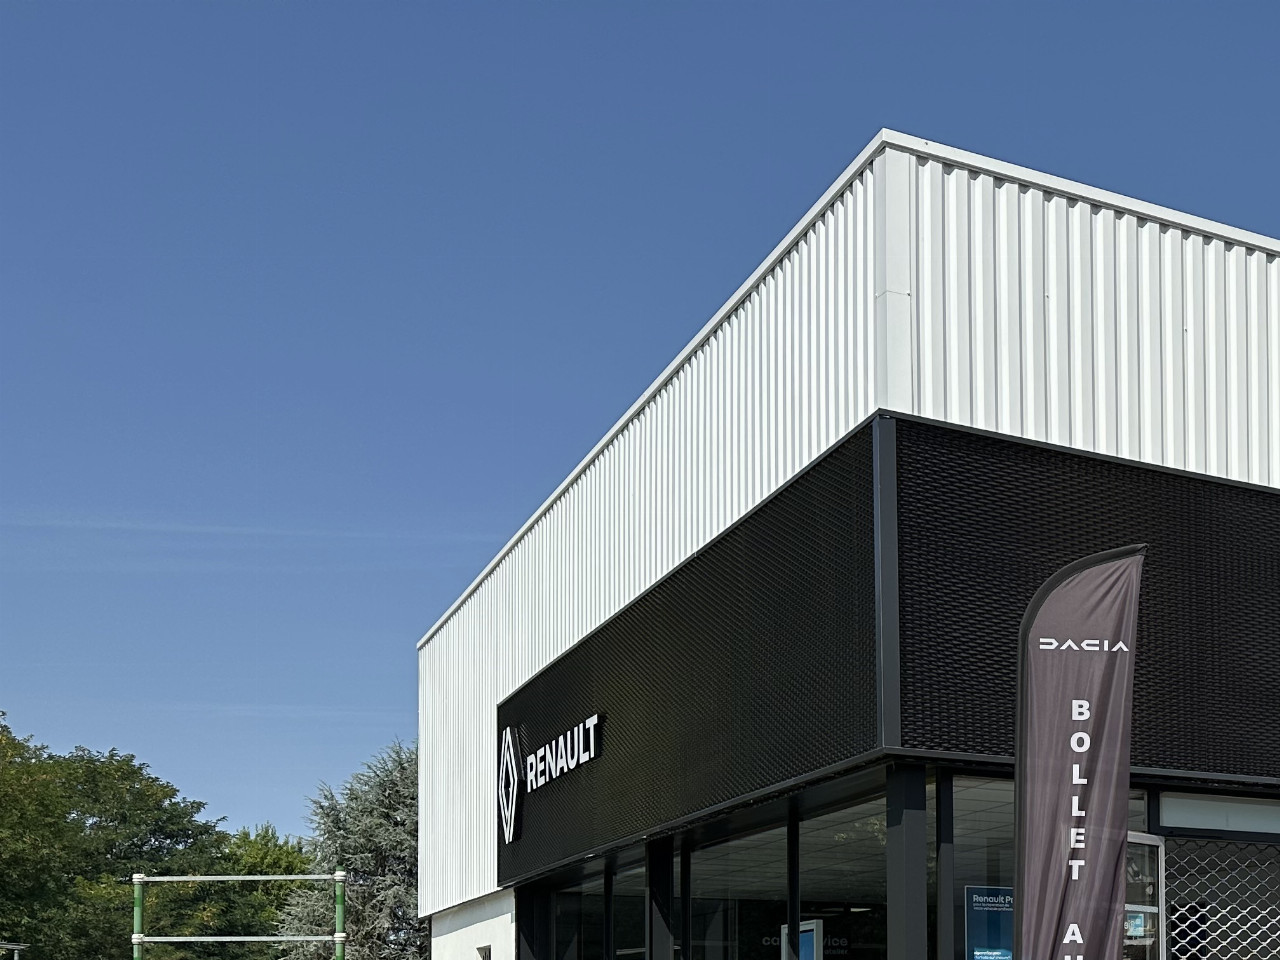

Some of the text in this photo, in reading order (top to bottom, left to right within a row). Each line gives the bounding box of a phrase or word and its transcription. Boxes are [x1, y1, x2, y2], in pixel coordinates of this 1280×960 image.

[1039, 637, 1129, 652] DACIA
[526, 713, 598, 793] RENAULT
[1069, 699, 1091, 880] BOLLET
[972, 894, 1005, 904] Renault
